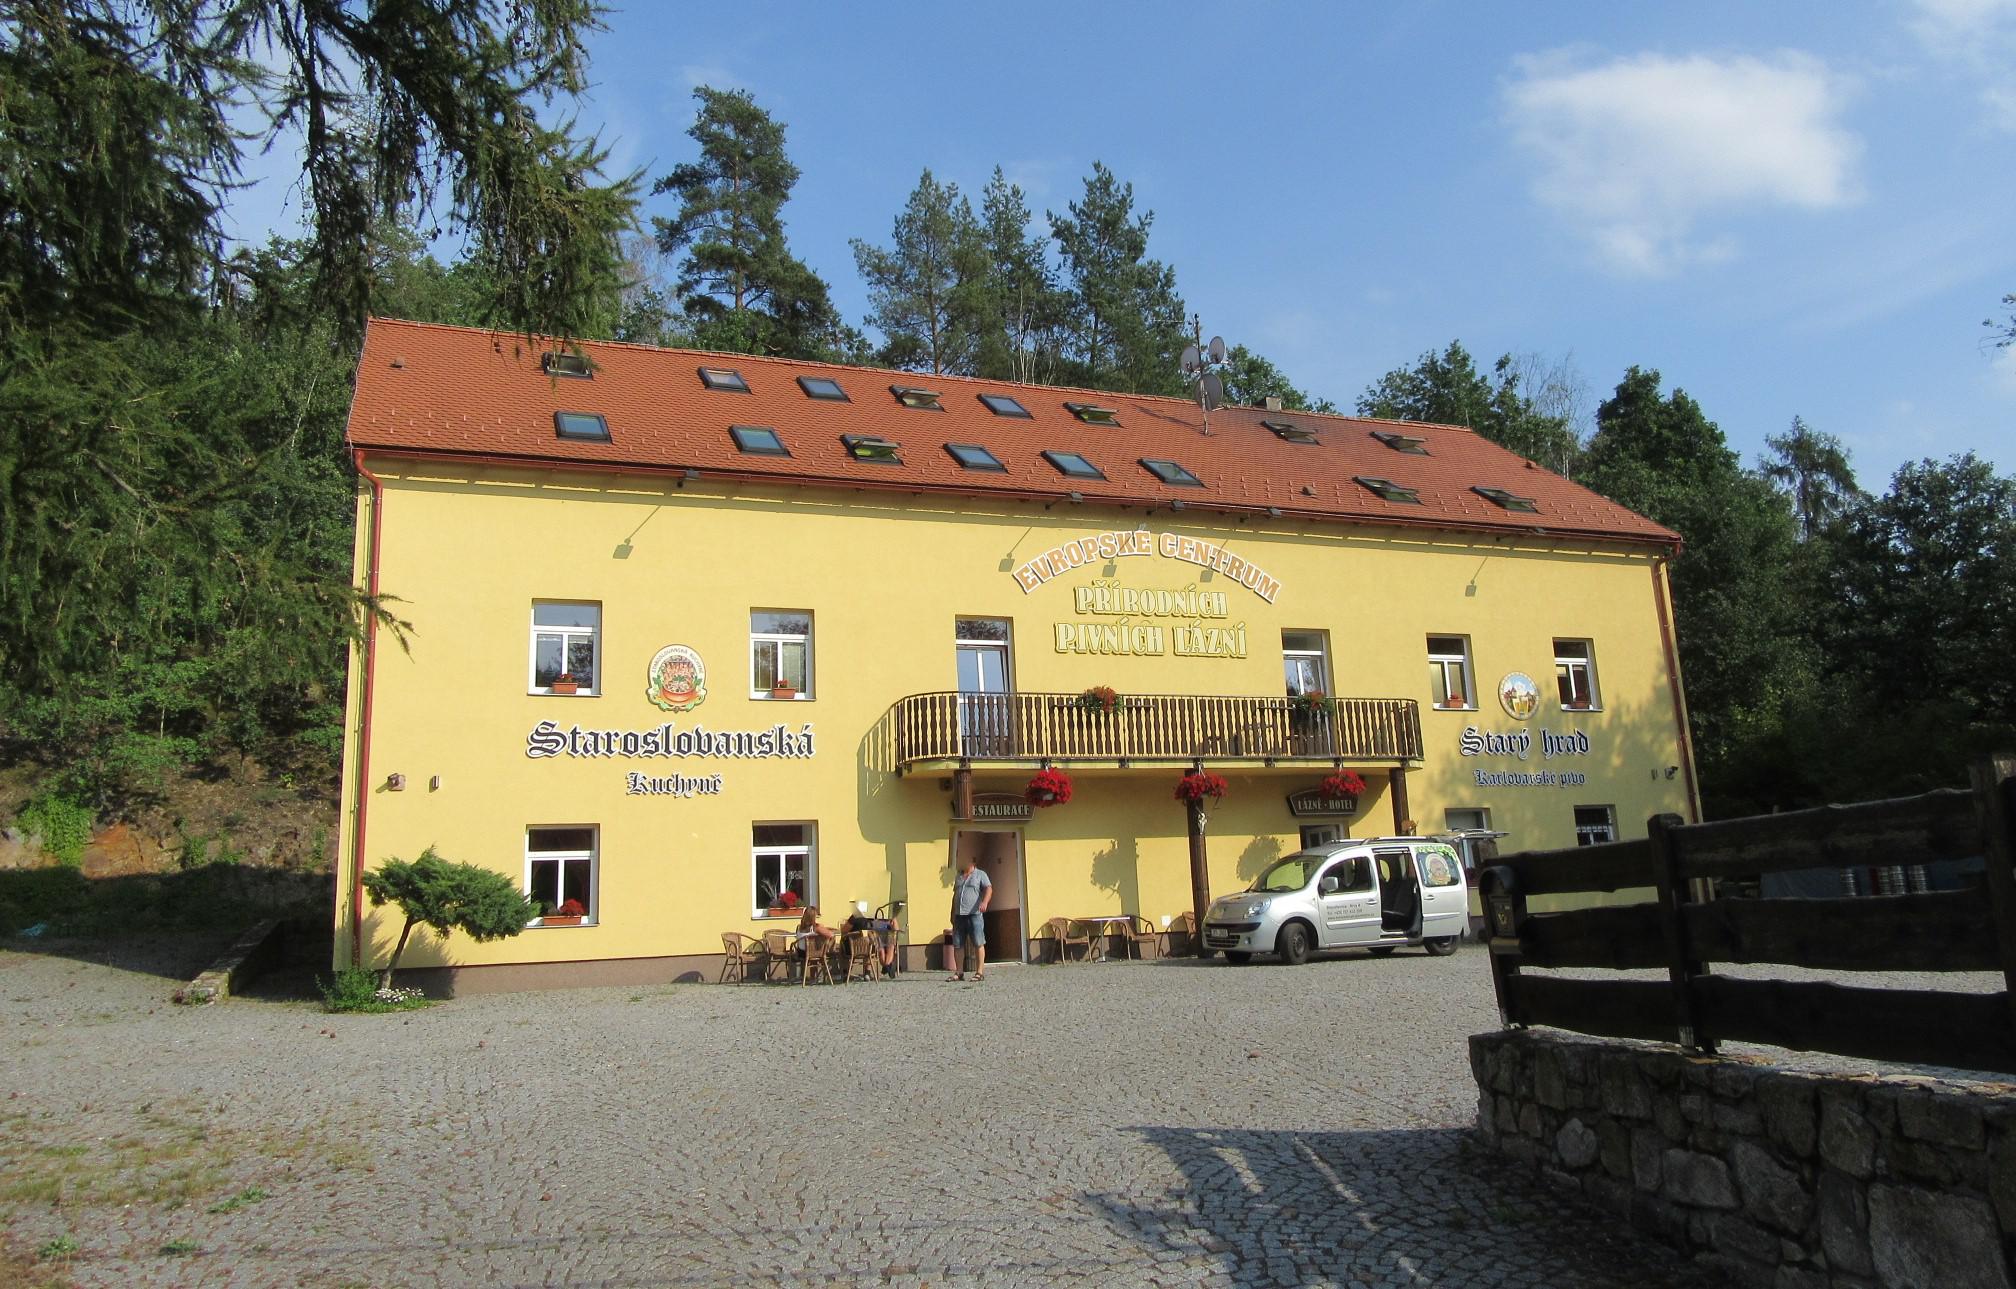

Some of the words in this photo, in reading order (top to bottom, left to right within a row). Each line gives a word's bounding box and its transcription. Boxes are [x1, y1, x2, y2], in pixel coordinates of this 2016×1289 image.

[1013, 523, 1152, 594] EVROPSKÉ
[1159, 532, 1281, 604] CENTRUM
[1074, 580, 1228, 618] PŘÍRODNÍCH
[1055, 617, 1164, 655] PIVNÍCH
[1174, 620, 1248, 658] LÁZNÍ
[526, 720, 816, 760] Staroslovanská
[1460, 726, 1529, 760] Starý
[1540, 728, 1590, 759] hrad
[626, 771, 722, 799] Kuchyně
[1560, 772, 1586, 788] pivo
[972, 804, 1030, 817] ESTAURACE
[1329, 799, 1353, 810] HOTEL
